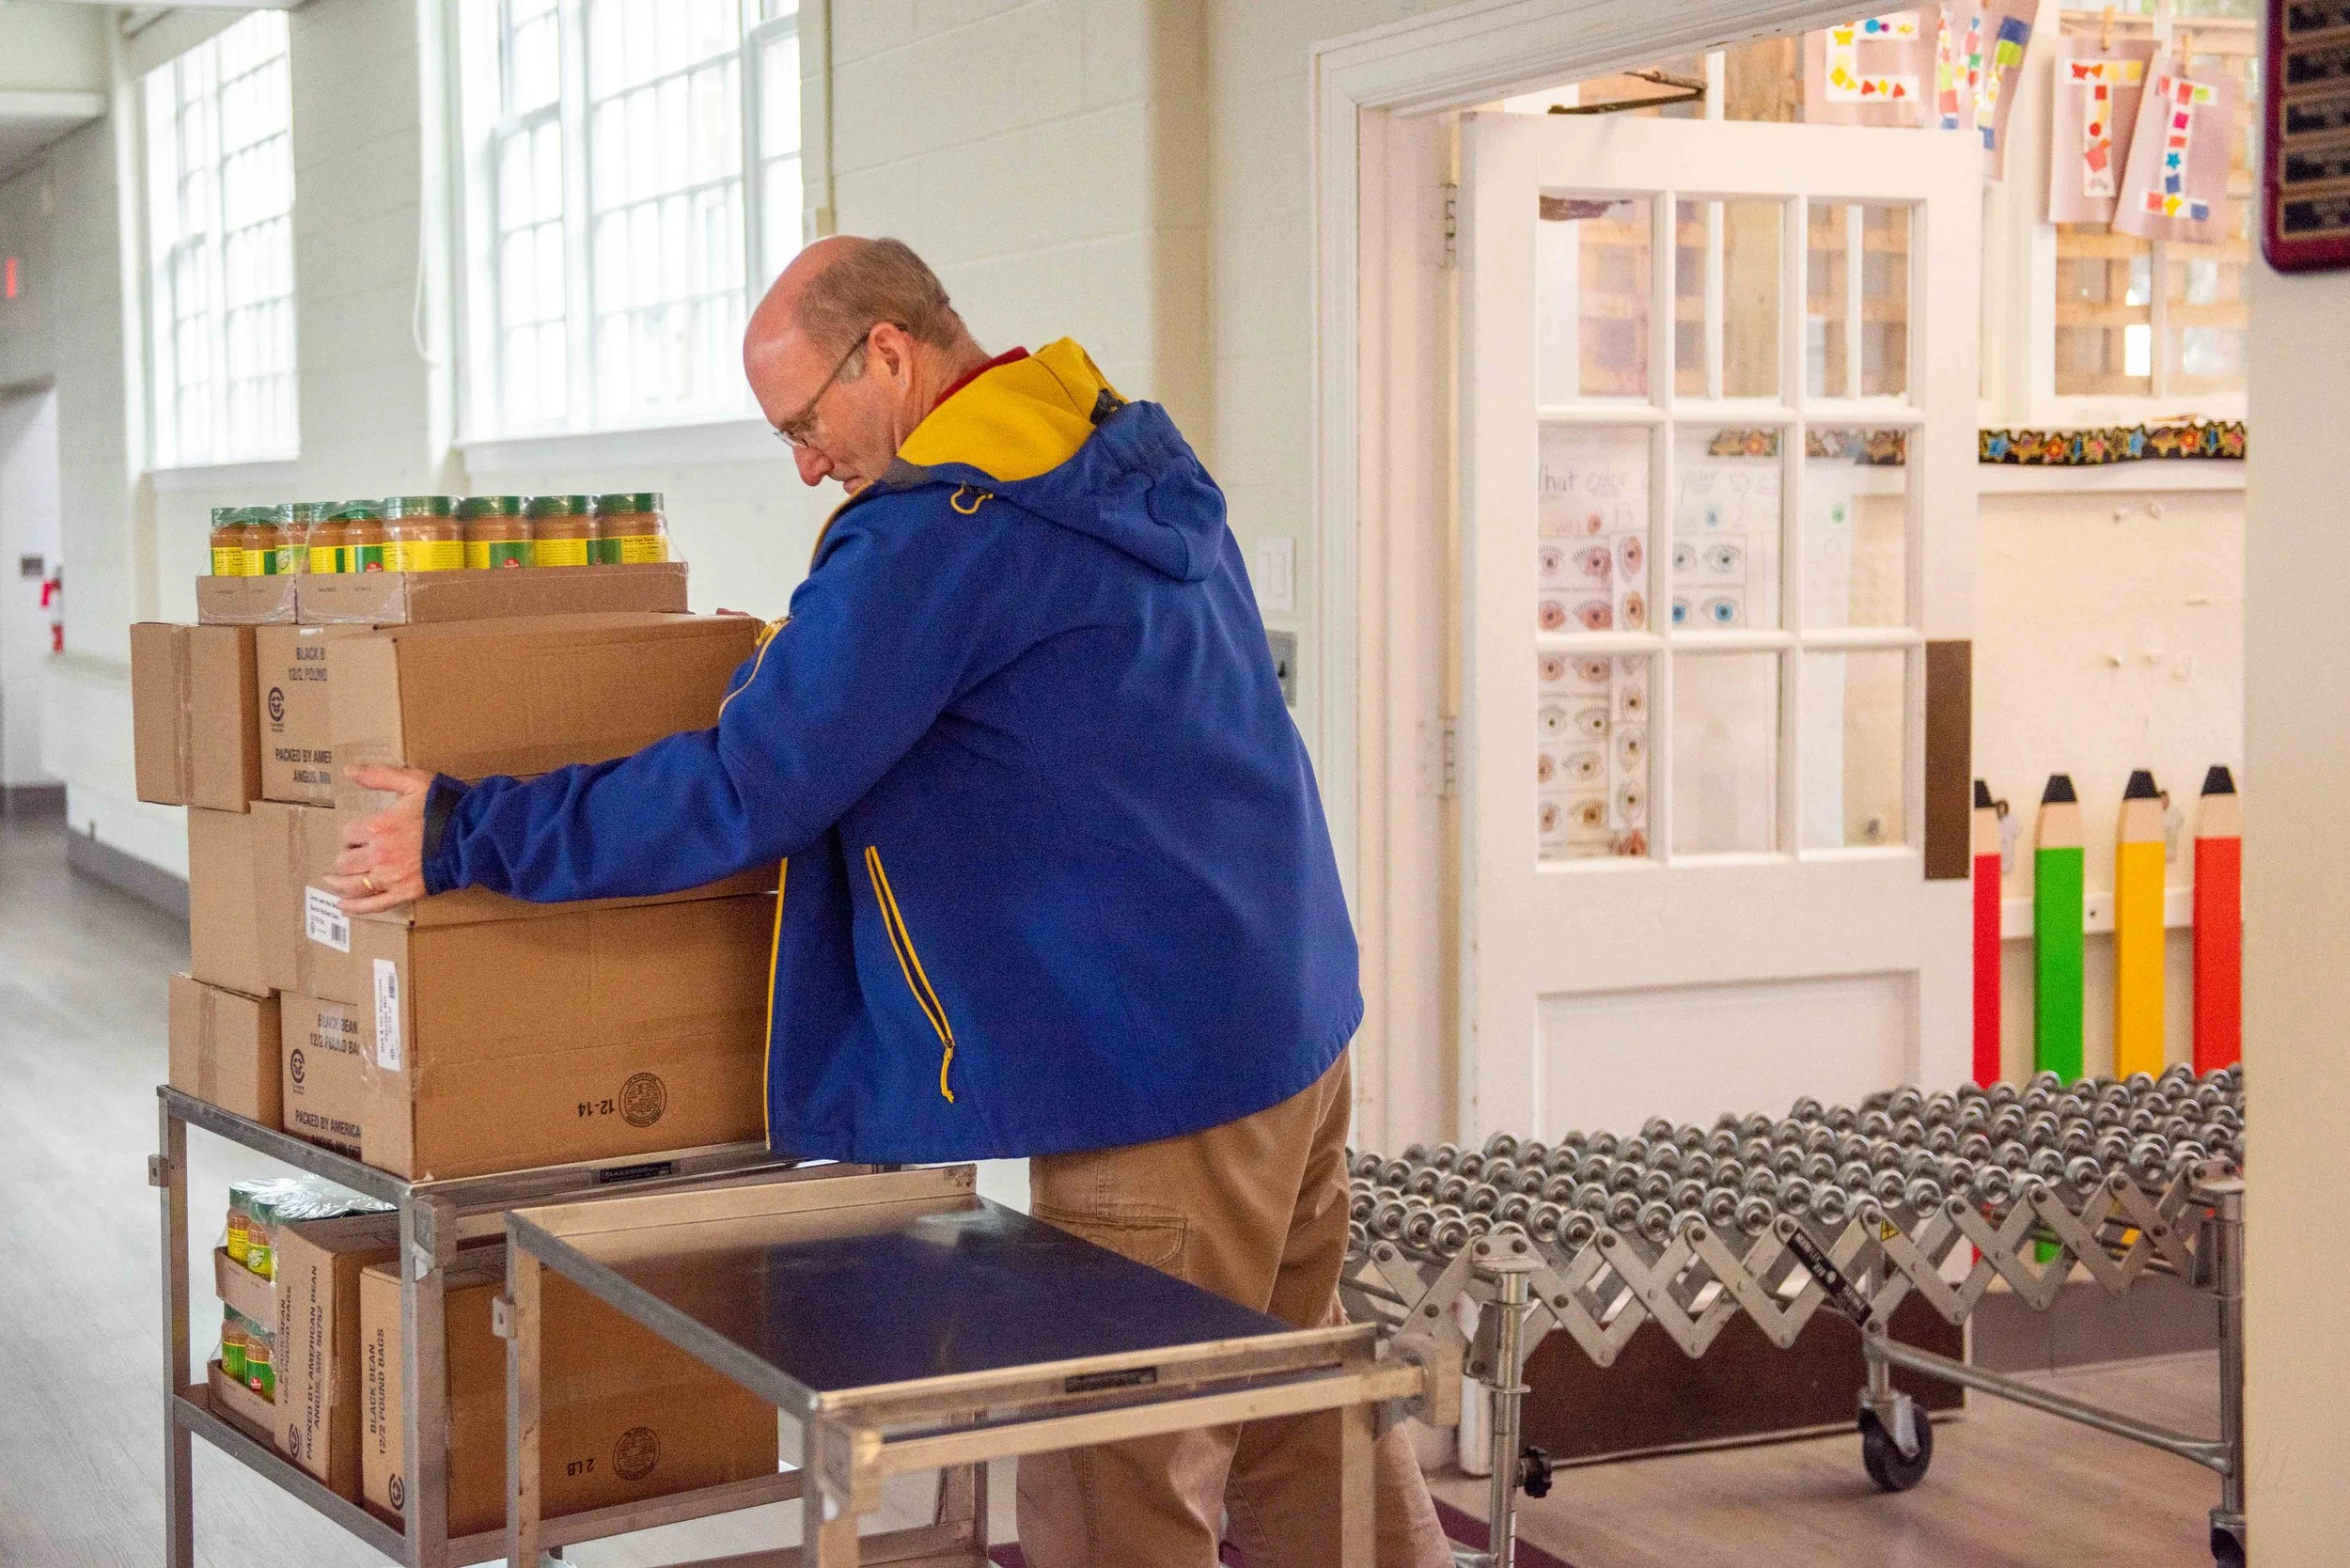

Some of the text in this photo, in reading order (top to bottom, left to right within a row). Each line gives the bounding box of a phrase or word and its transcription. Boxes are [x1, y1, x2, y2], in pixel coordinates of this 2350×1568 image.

[577, 1098, 615, 1118] 12-14
[295, 1109, 319, 1128] PACKED
[307, 1382, 314, 1402] BY
[368, 1388, 377, 1435] BLACK
[378, 1424, 386, 1454] 12/2
[567, 1458, 595, 1477] 2 LB
